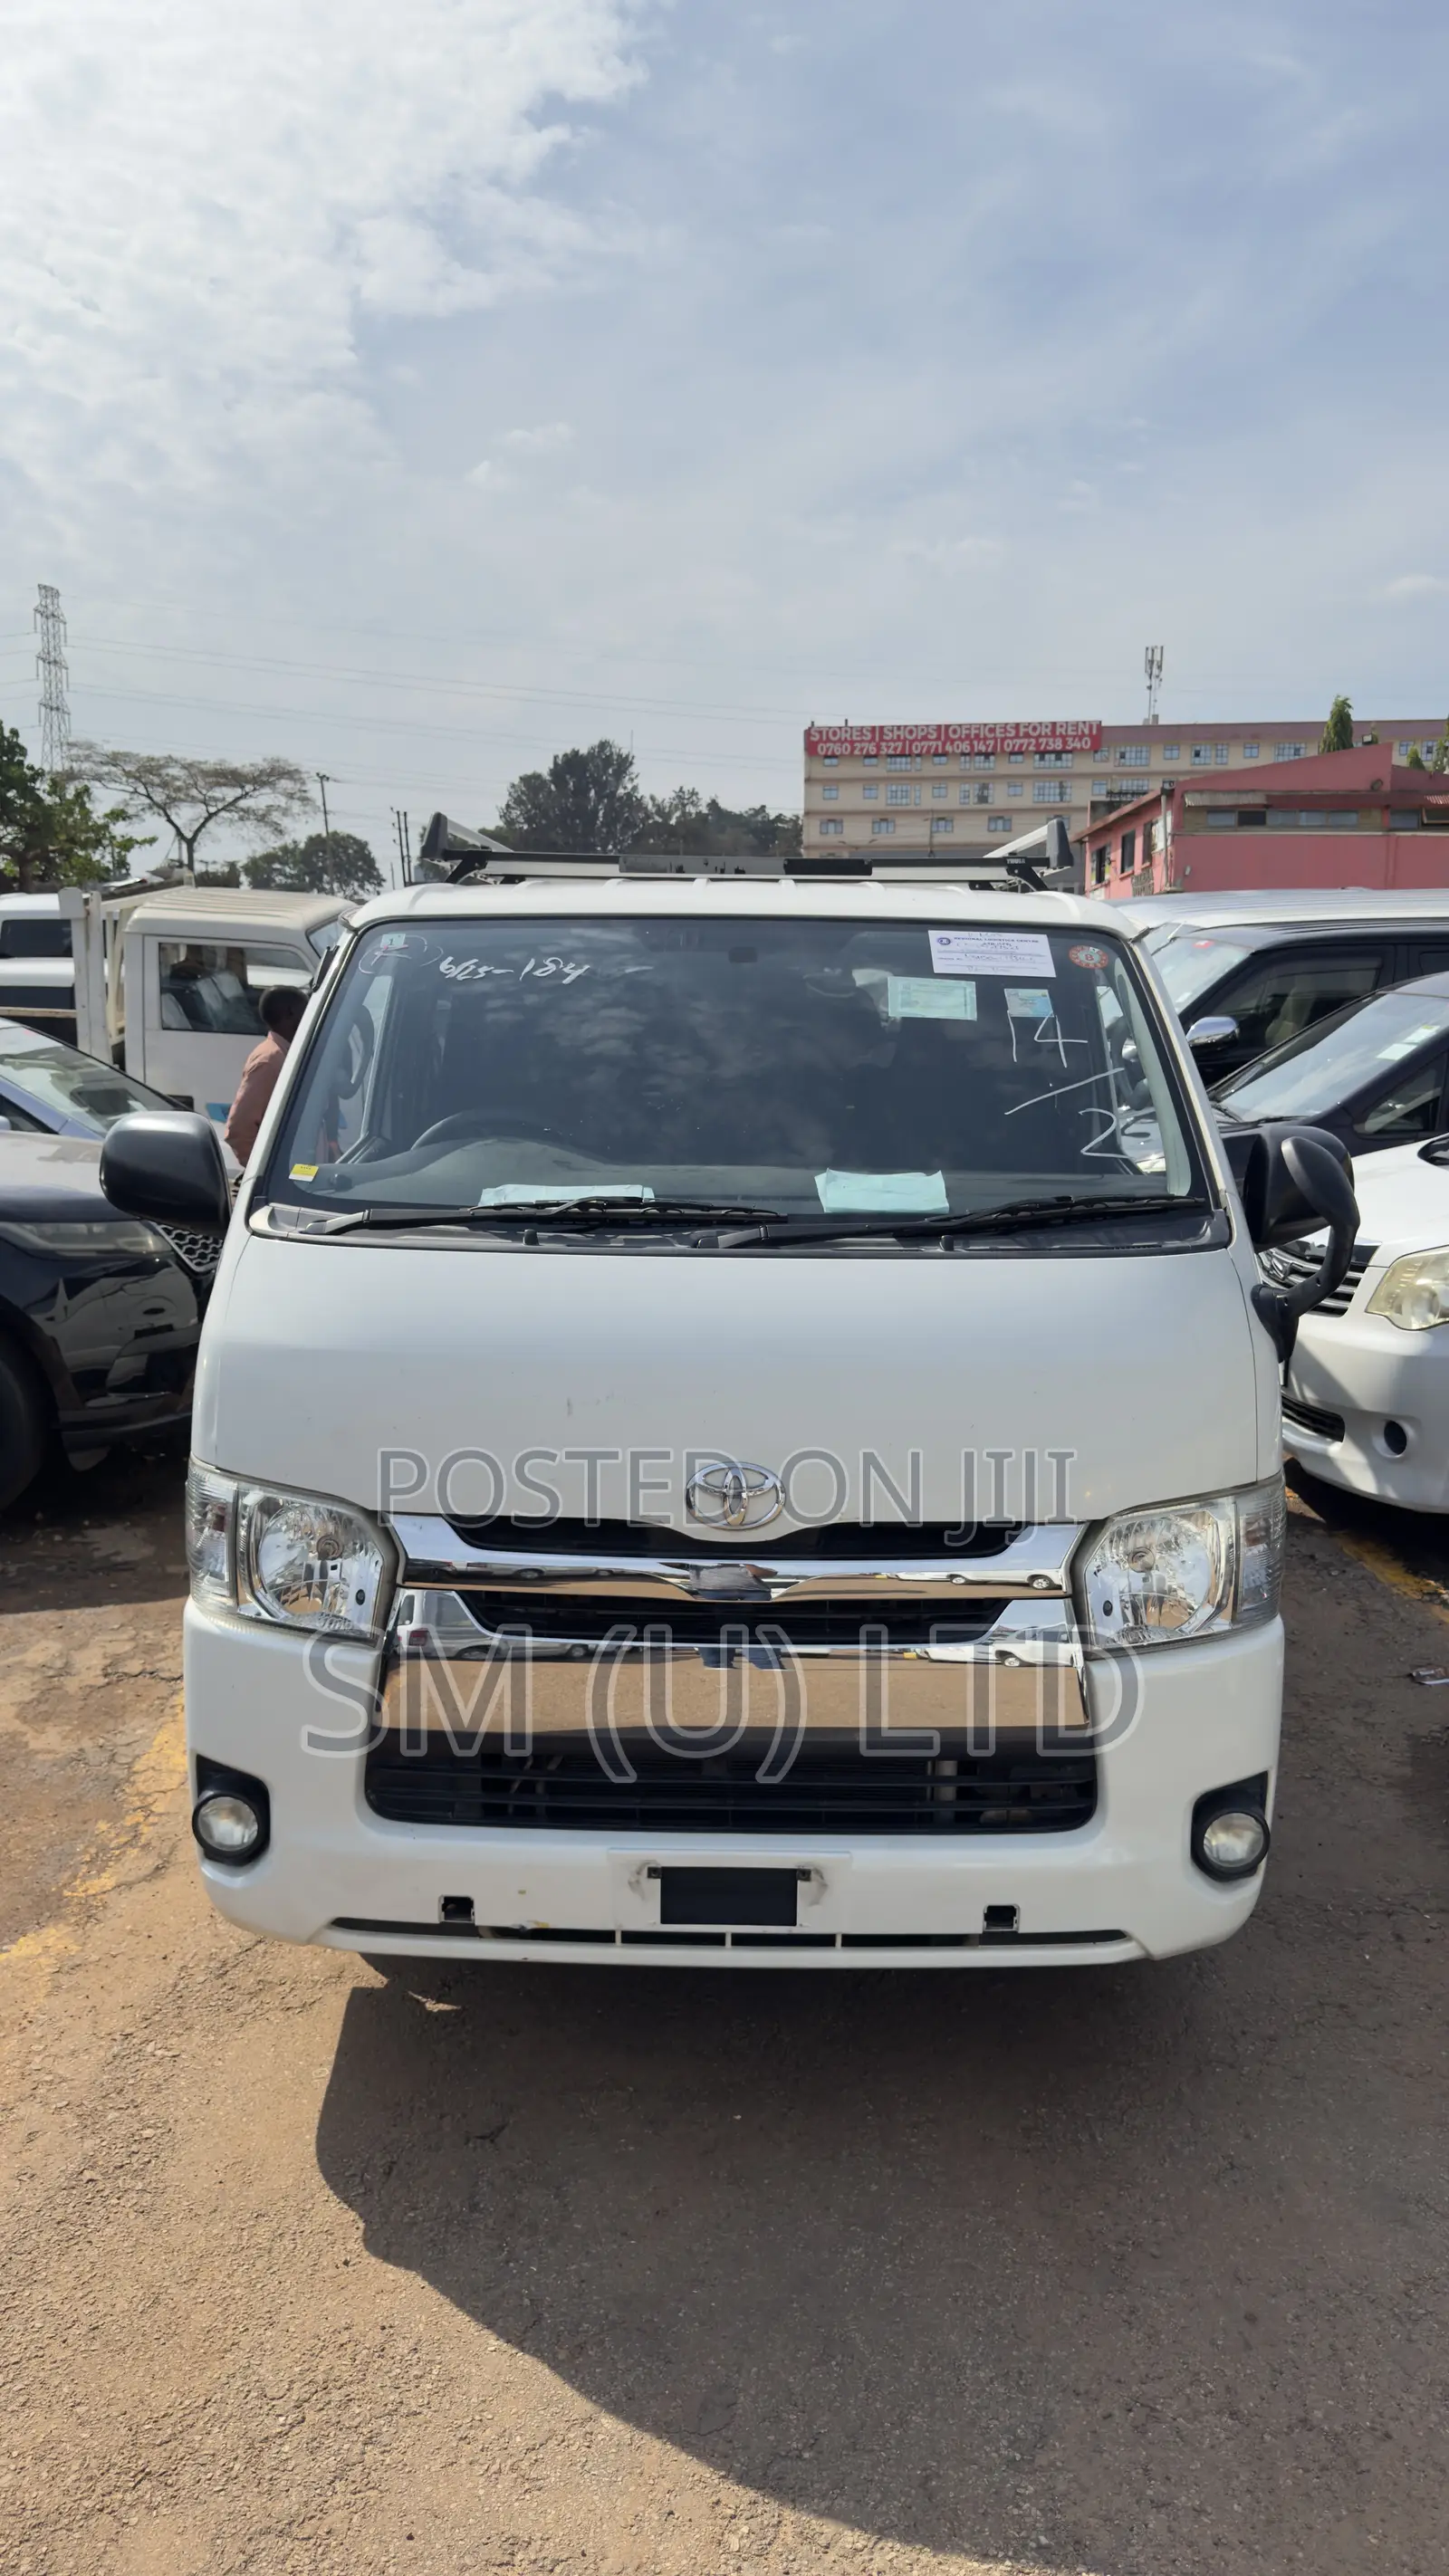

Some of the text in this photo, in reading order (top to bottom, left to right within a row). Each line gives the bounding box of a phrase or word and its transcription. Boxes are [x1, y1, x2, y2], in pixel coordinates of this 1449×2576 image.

[810, 721, 1099, 741] STORES SHOPS OFFICES FOR RENT
[817, 736, 1091, 754] 0760 276 327 0771 406 147 0772 738 340
